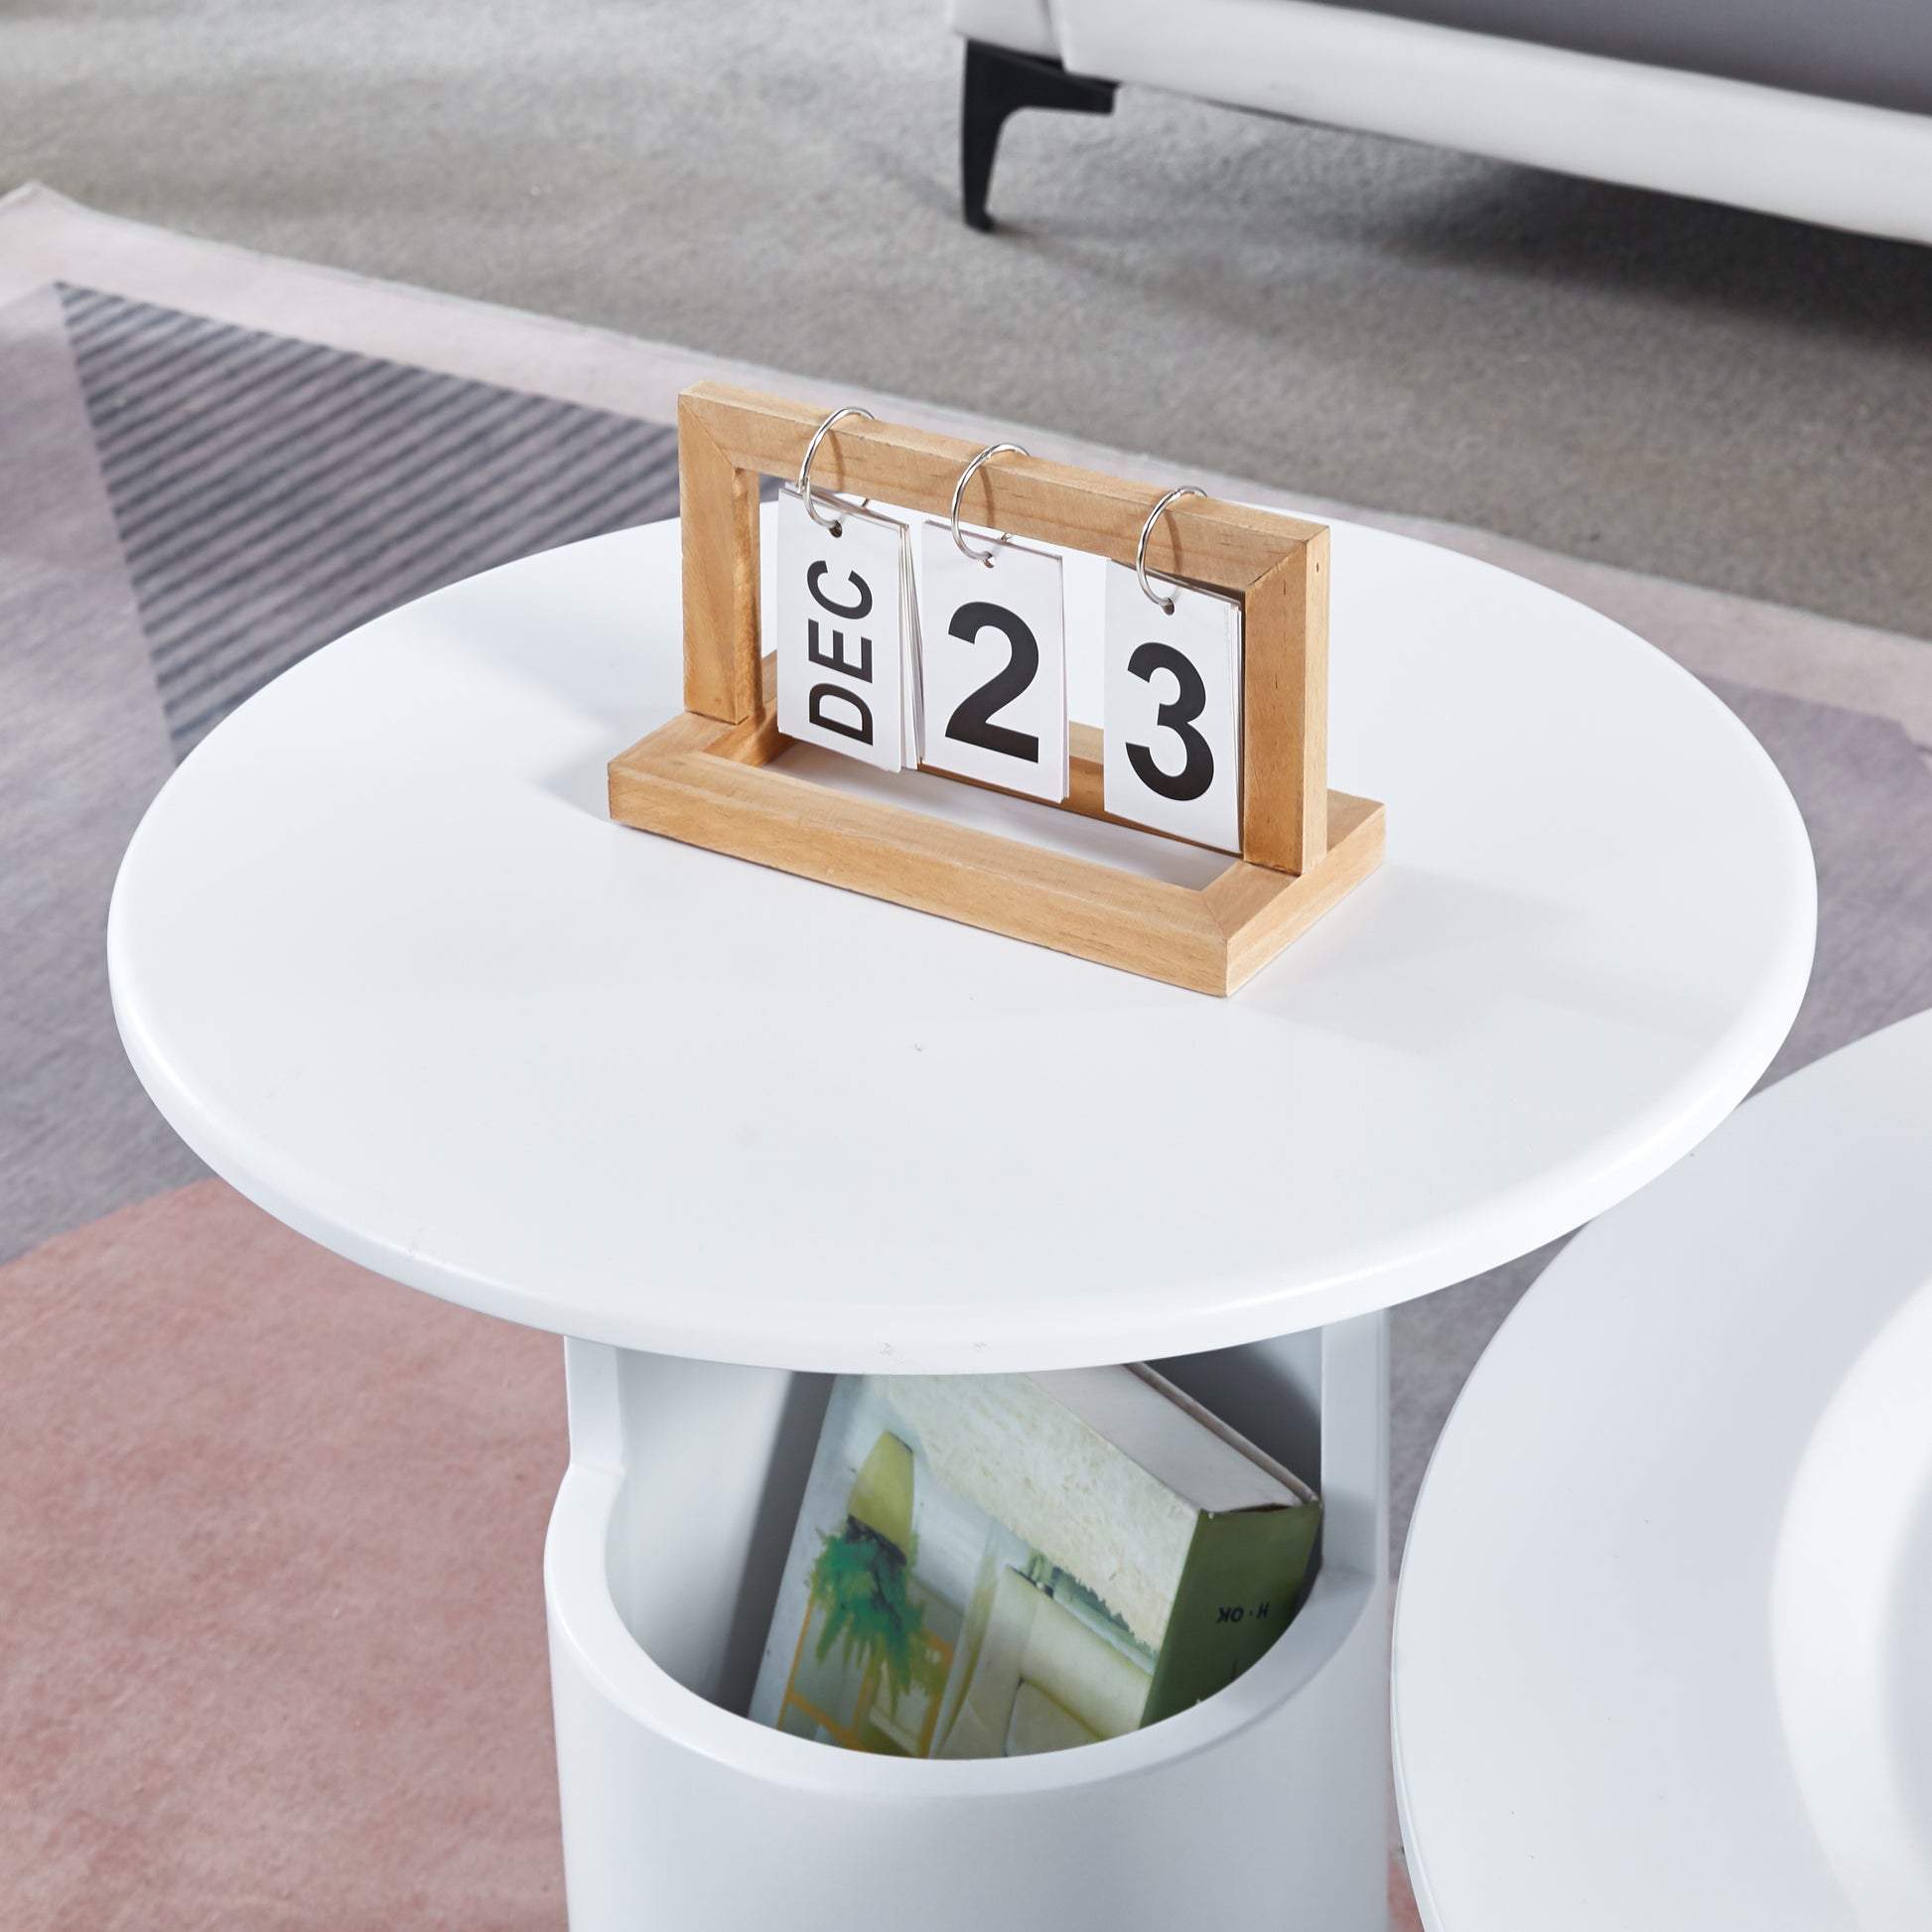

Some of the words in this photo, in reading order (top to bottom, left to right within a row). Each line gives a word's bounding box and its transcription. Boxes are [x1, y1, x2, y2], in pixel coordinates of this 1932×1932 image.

[806, 560, 874, 747] DEC
[944, 602, 1039, 763] 2
[1125, 641, 1214, 802] 3
